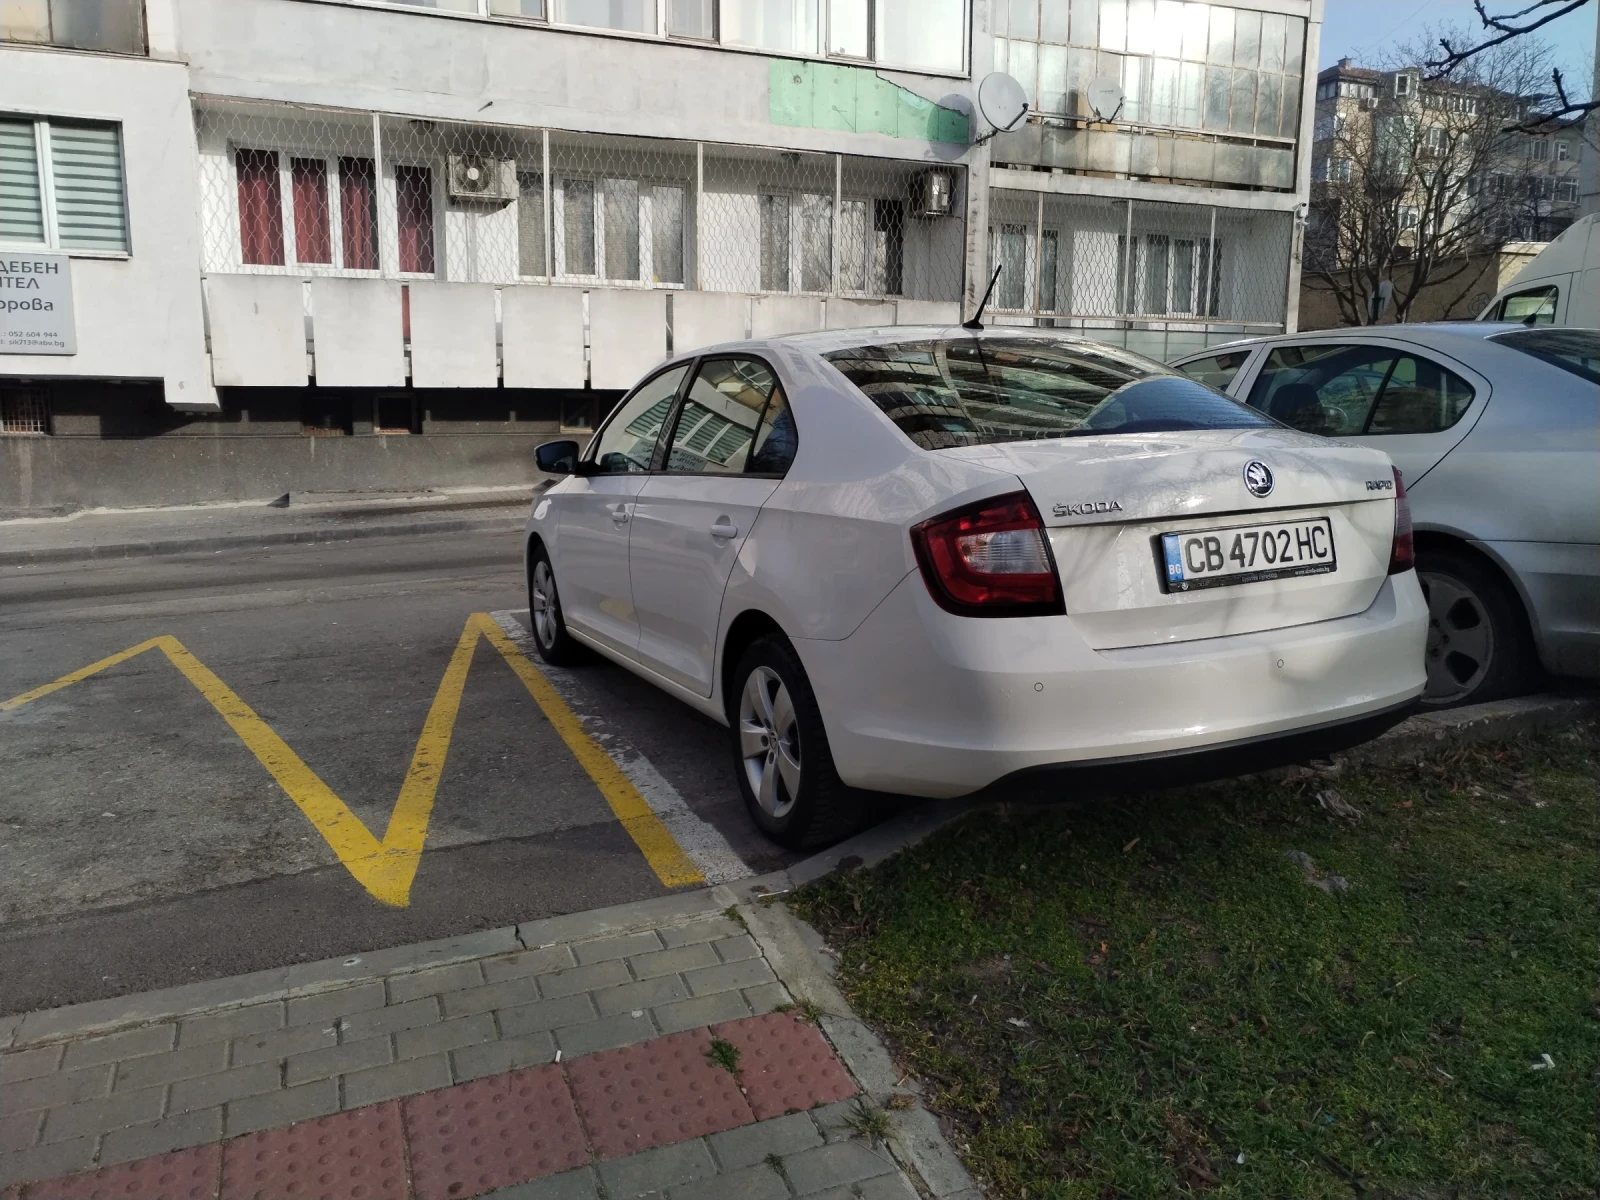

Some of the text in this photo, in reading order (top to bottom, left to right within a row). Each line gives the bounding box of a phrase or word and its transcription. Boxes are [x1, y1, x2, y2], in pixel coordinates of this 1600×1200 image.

[1365, 480, 1393, 491] RAPID
[1053, 501, 1123, 517] ŠKODA
[1184, 525, 1328, 573] CB 4702 HC
[1168, 564, 1182, 575] BG
